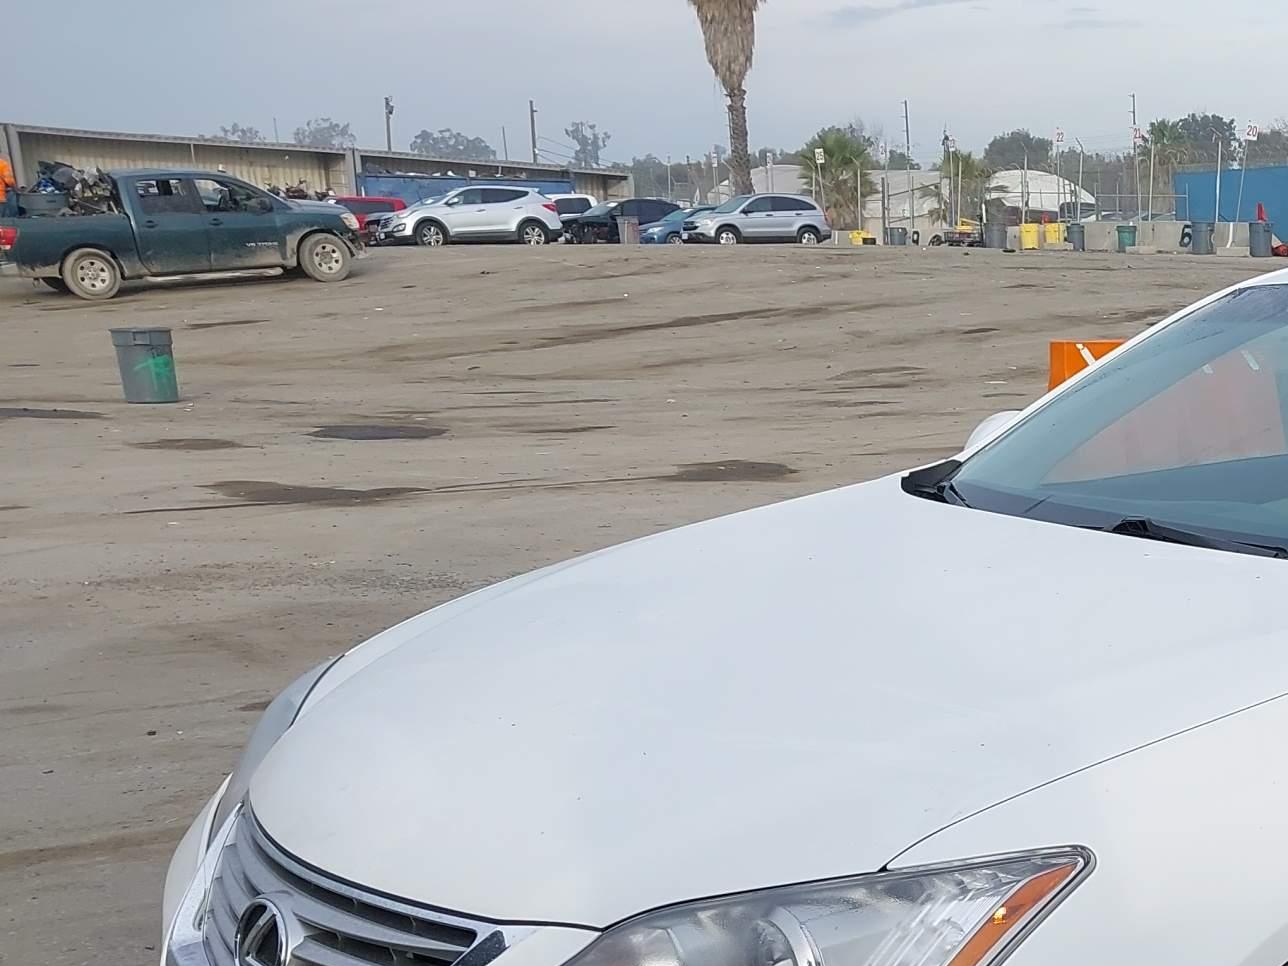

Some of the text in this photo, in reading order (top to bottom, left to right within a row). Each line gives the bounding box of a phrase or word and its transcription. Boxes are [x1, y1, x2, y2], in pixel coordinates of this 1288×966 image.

[1133, 127, 1141, 139] 21
[1246, 125, 1258, 137] 20
[1056, 132, 1064, 142] 22
[815, 151, 824, 161] 25
